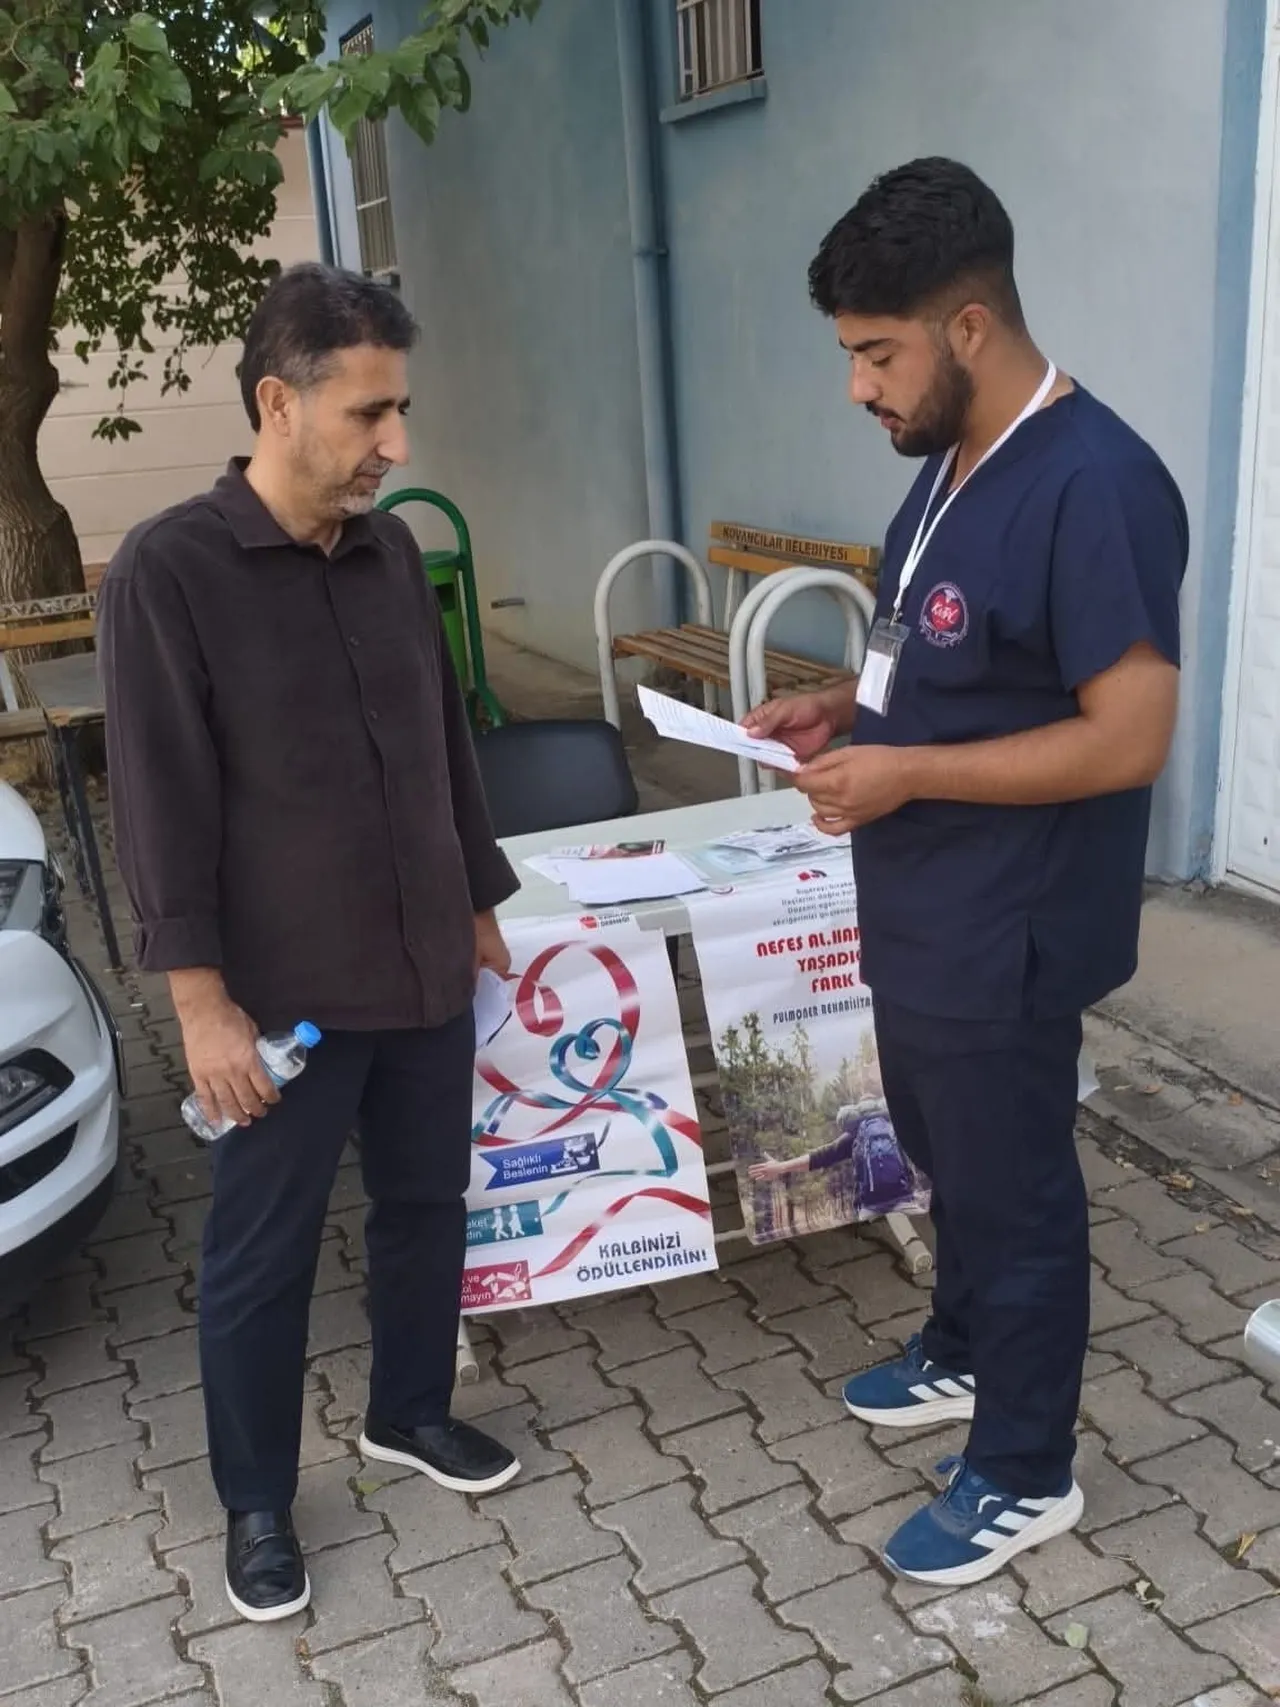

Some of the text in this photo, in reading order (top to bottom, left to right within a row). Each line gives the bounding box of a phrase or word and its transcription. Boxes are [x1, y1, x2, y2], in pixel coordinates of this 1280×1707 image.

[756, 936, 804, 957] NEFES
[811, 973, 854, 993] FARK
[773, 996, 872, 1024] PULMONER REHABİLİTA
[503, 1164, 549, 1180] Beslenin
[599, 1231, 682, 1260] KALBİNİZİ
[577, 1249, 708, 1282] ÖDÜLLENDİRİN!
